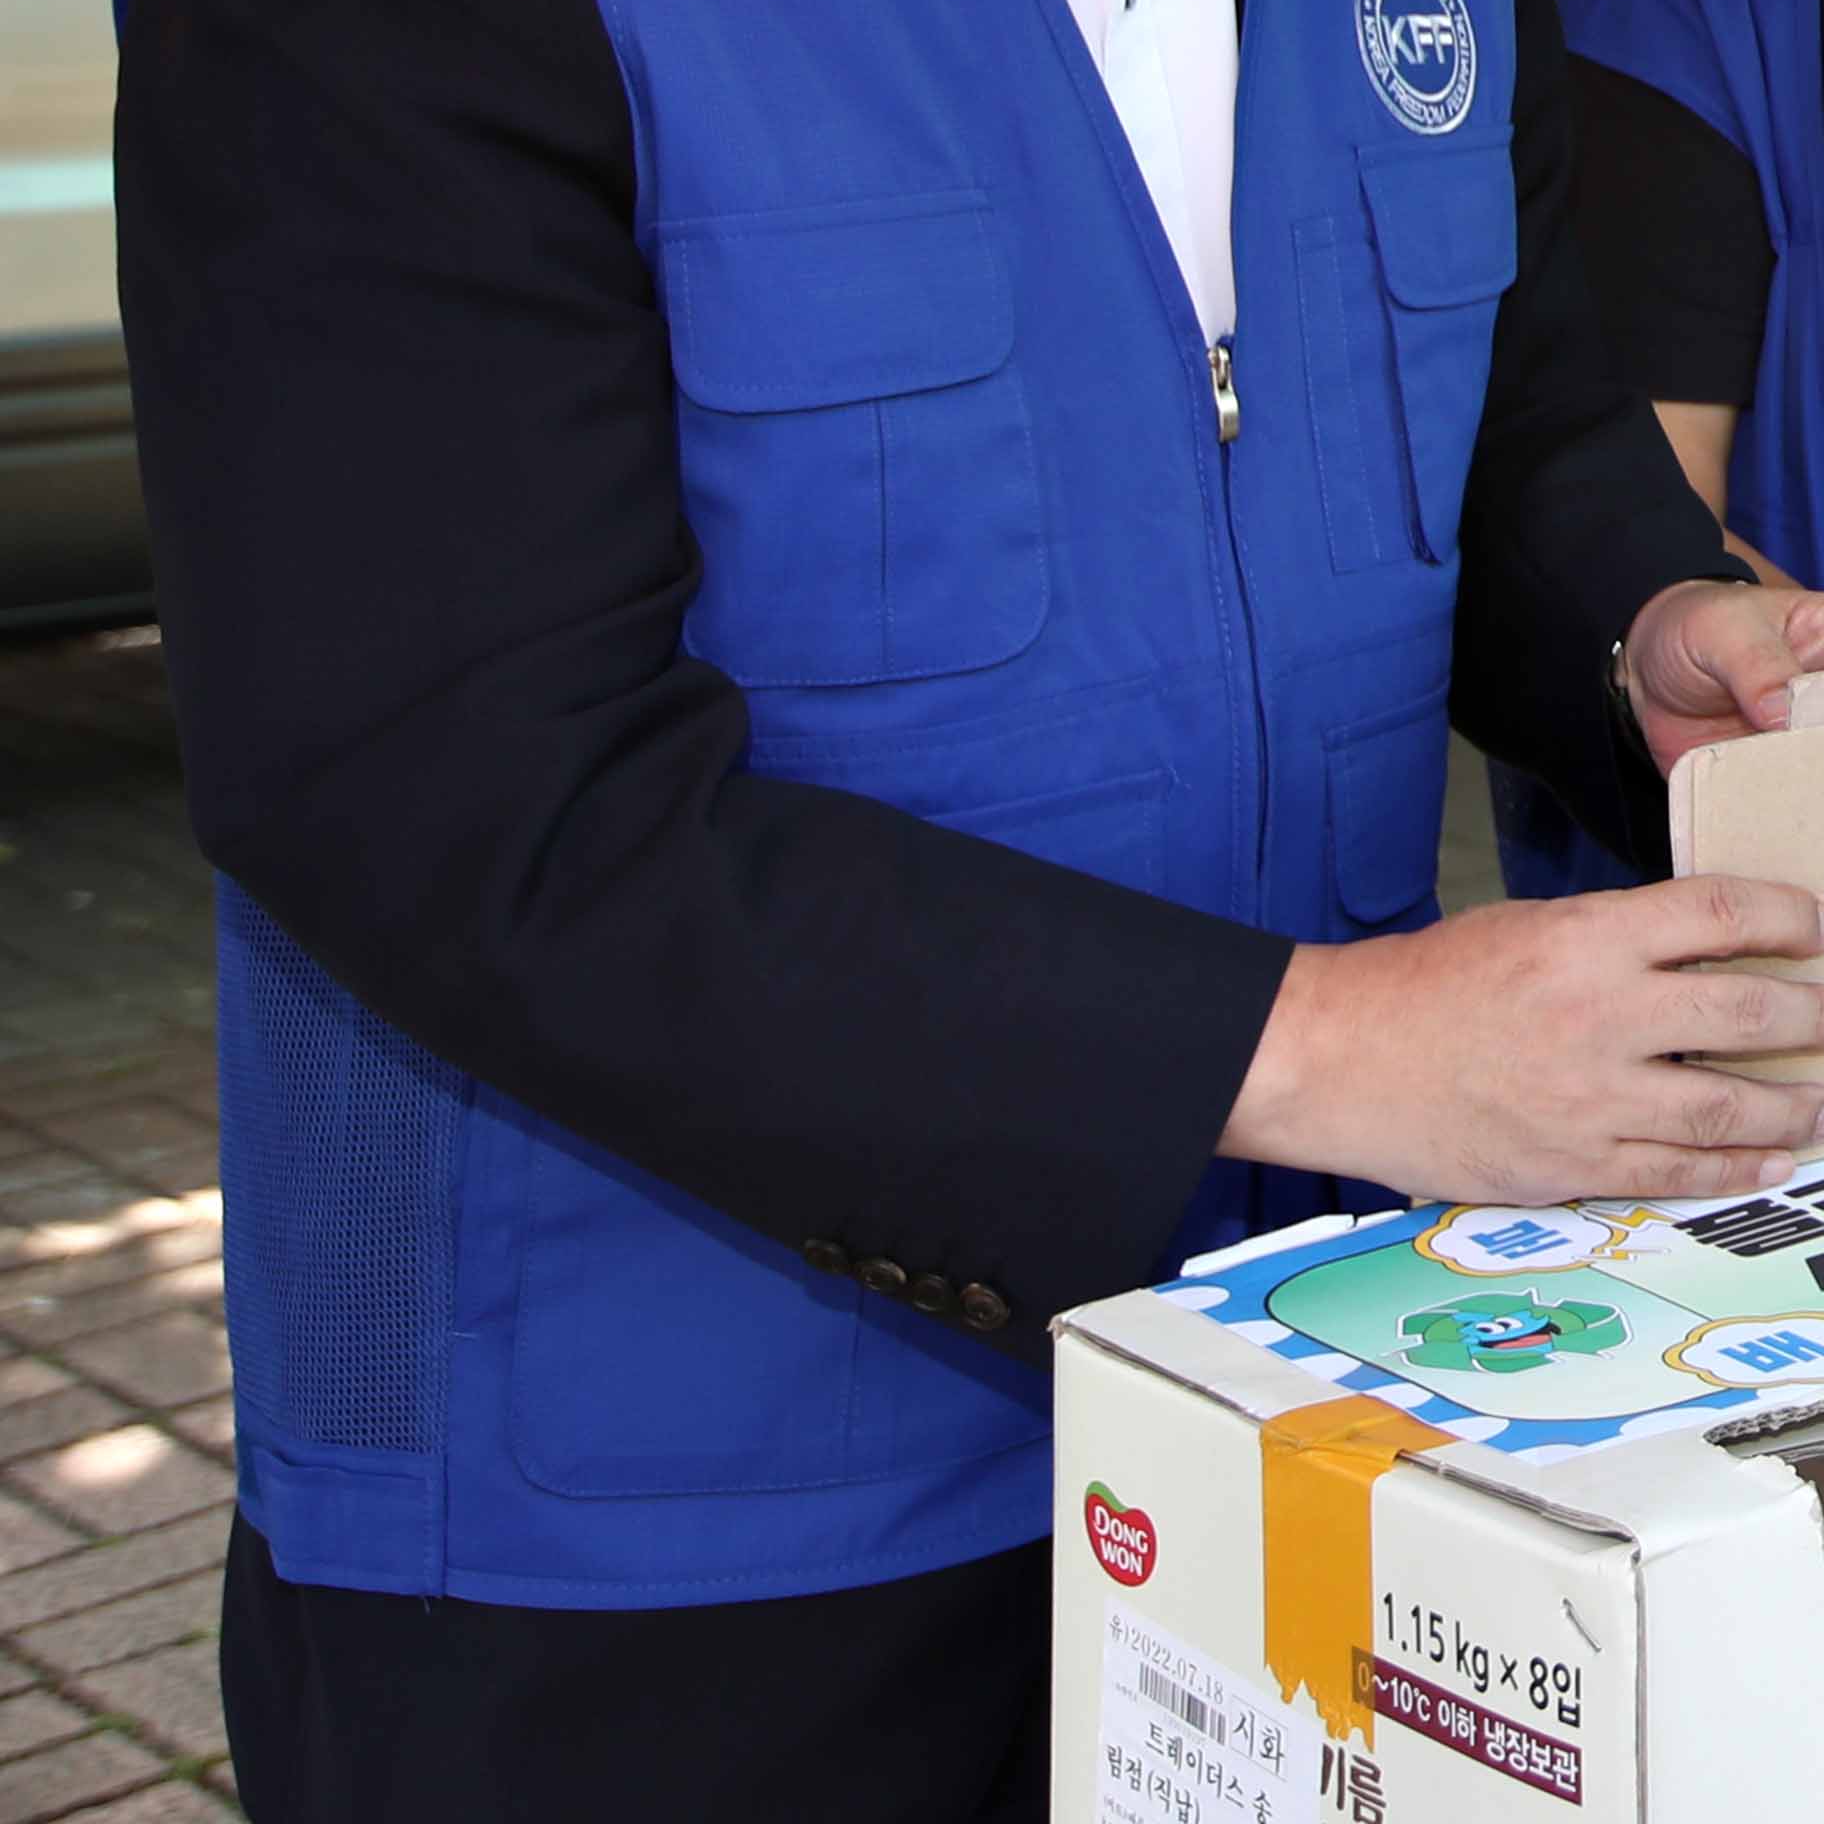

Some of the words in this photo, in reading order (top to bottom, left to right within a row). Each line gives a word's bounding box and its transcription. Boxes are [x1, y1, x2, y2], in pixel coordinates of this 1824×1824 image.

[1381, 13, 1453, 64] KFF
[1094, 1504, 1149, 1555] DONG
[1099, 1537, 1144, 1577] WON
[1384, 1592, 1446, 1664] 1.15
[1456, 1621, 1490, 1694] kg
[1529, 1656, 1582, 1729] 8입
[1145, 1722, 1245, 1809] 트레이더스
[1233, 1710, 1285, 1775] 시화
[1438, 1701, 1477, 1747] 이하
[1484, 1716, 1579, 1794] 냉장보관
